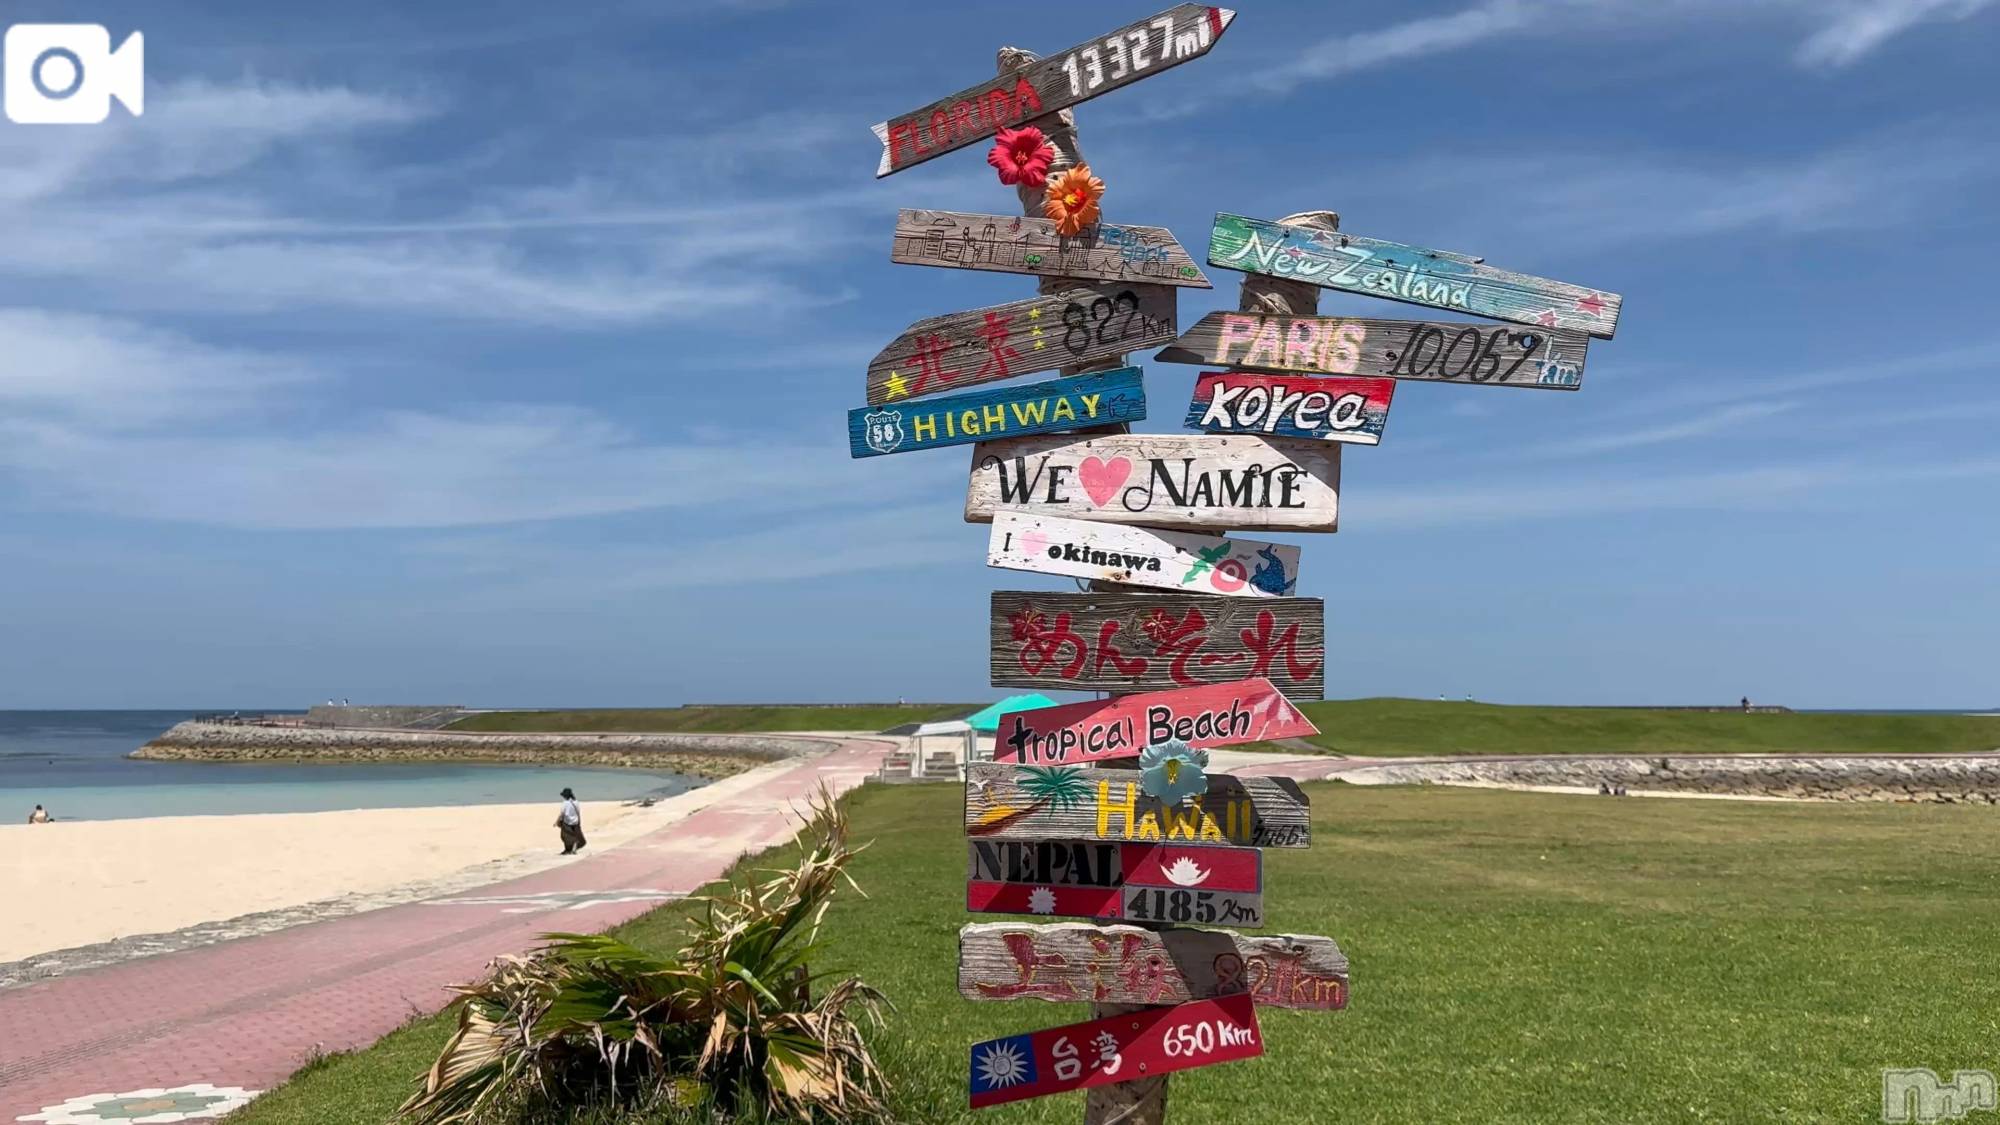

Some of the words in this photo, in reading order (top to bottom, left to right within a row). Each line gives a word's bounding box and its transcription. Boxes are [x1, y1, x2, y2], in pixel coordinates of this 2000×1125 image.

[887, 77, 1042, 166] FLORIDA
[1229, 230, 1330, 276] New
[1327, 245, 1473, 308] Zealand
[903, 311, 1023, 392] 北京
[1214, 315, 1367, 373] PARIS
[873, 424, 895, 443] 58
[913, 393, 1101, 442] HIGHWAY
[980, 455, 1073, 504] WE
[1122, 458, 1308, 512] NAMIE
[1003, 533, 1012, 551] I
[1047, 542, 1161, 572] okinawa
[1148, 699, 1252, 745] Beach
[973, 841, 1124, 887] NEPAL
[1127, 889, 1218, 922] 4185
[1052, 1030, 1122, 1081] 台湾
[1163, 1019, 1215, 1058] 650
